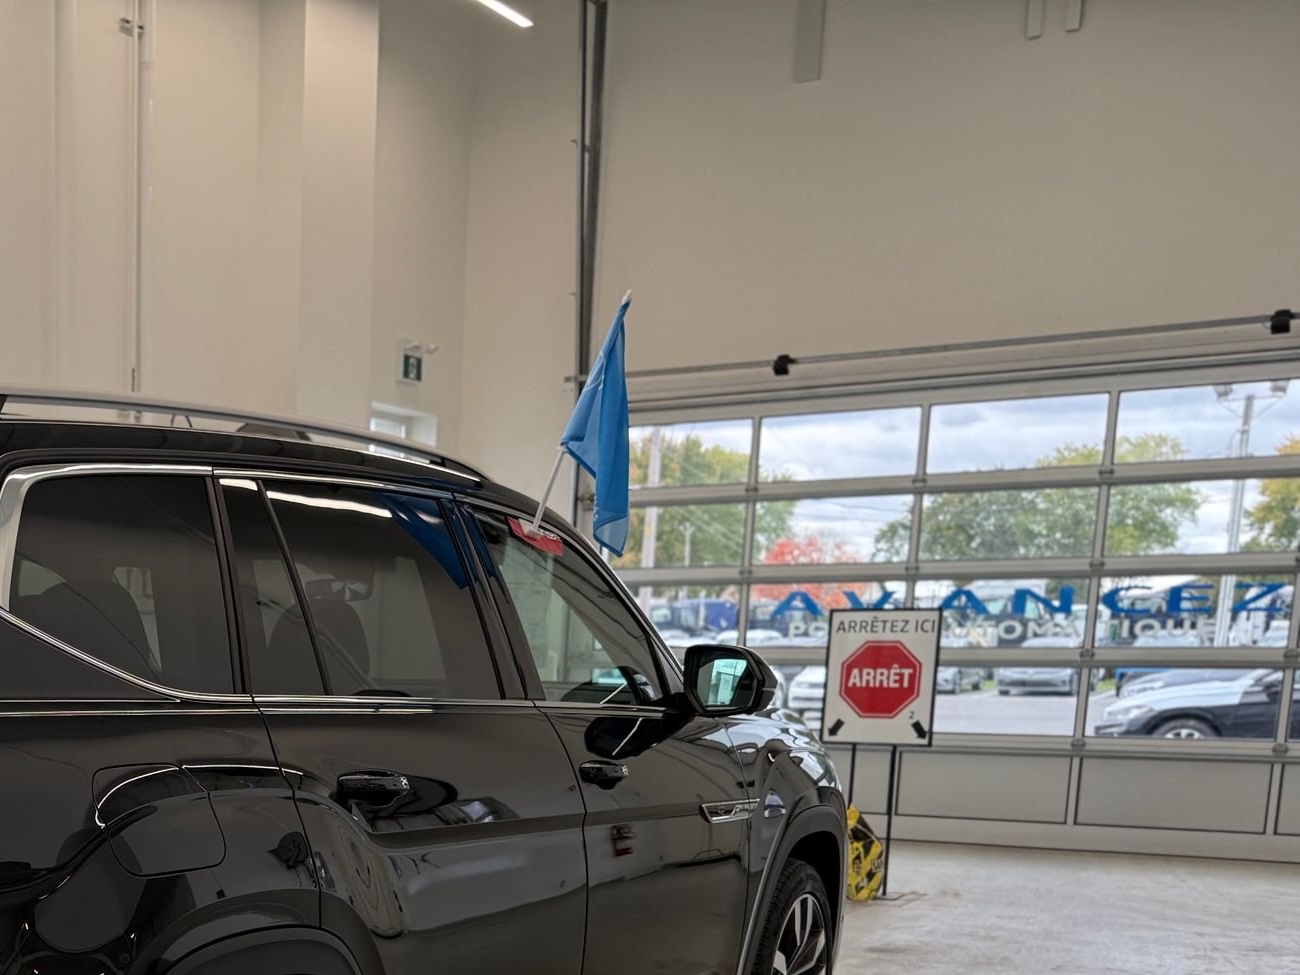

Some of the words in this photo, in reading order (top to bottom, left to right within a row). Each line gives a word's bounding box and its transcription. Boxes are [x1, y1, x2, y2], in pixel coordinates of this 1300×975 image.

[771, 582, 1285, 616] AVANCEZ
[836, 616, 910, 633] ARRÊTEZ
[914, 619, 936, 633] ICI
[949, 618, 1217, 640] UTOMATIQUE
[848, 664, 914, 688] ARRÊT
[908, 710, 915, 720] 2
